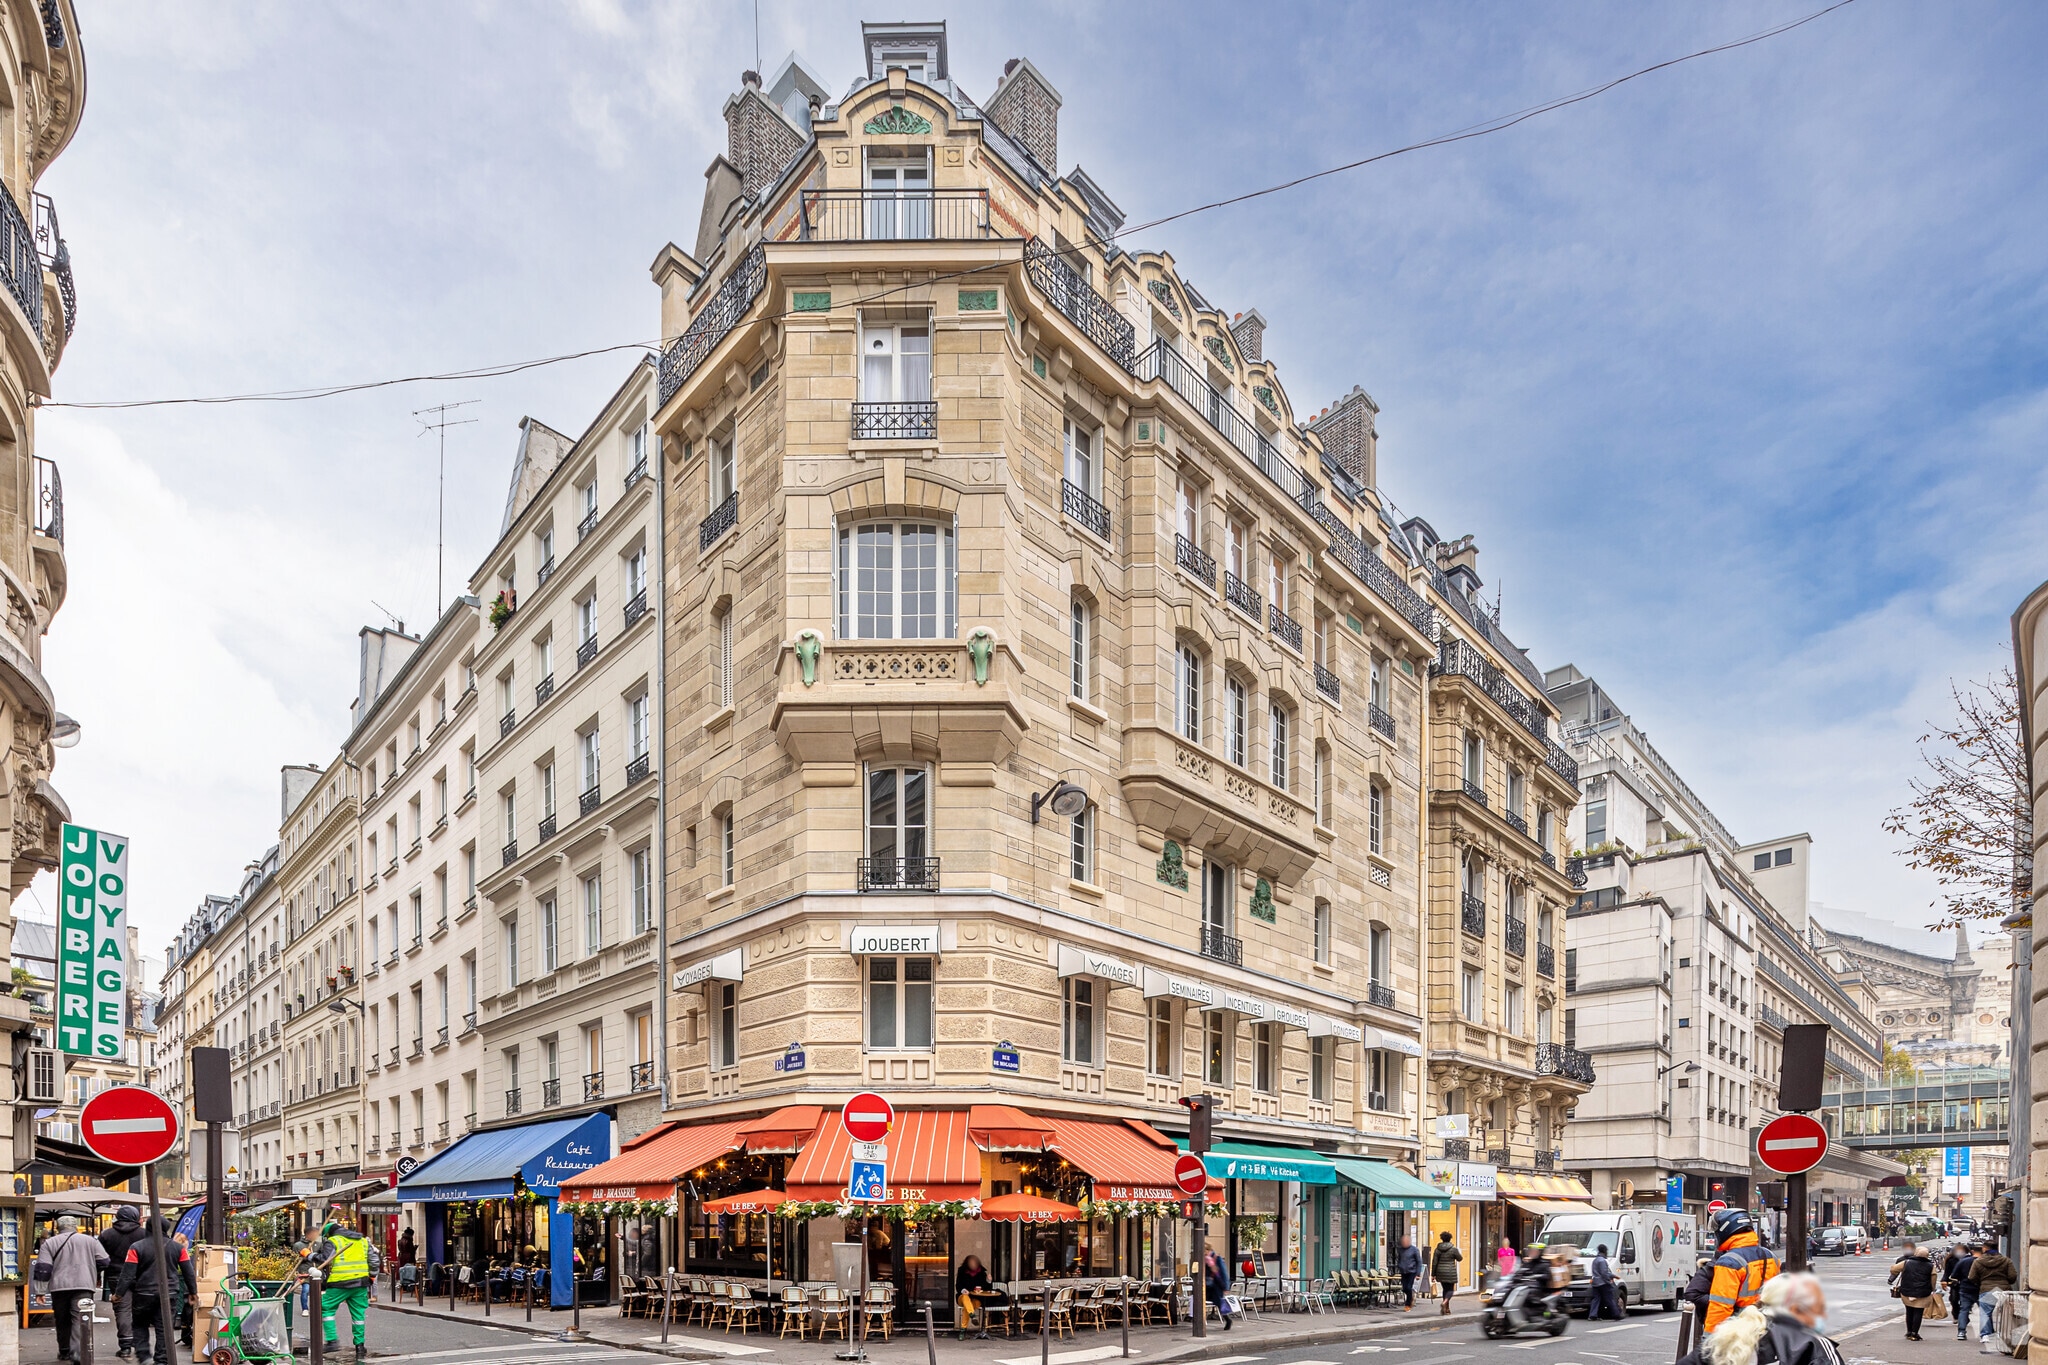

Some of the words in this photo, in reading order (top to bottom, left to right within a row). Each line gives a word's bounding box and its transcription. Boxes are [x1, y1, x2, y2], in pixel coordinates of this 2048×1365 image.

[61, 831, 94, 1050] JOUBERT
[96, 839, 125, 1057] VOYAGES
[858, 937, 930, 952] JOUBERT
[676, 964, 711, 985] VOYAGES
[1089, 958, 1134, 983] VOYAGES
[1171, 982, 1210, 1002] SEMINAIRES
[1227, 997, 1262, 1016] INCENTIVES
[1276, 1009, 1306, 1027] GROUPES
[776, 1060, 783, 1070] 13
[545, 1156, 605, 1169] Restaura
[592, 1188, 604, 1198] BAR
[606, 1187, 636, 1198] BRASSERIE
[900, 1187, 927, 1200] BEX
[1110, 1186, 1128, 1198] BAR
[1133, 1187, 1174, 1199] BRASSERIE
[731, 1202, 741, 1210] LE
[742, 1202, 757, 1210] BEX
[1679, 1221, 1692, 1245] elis
